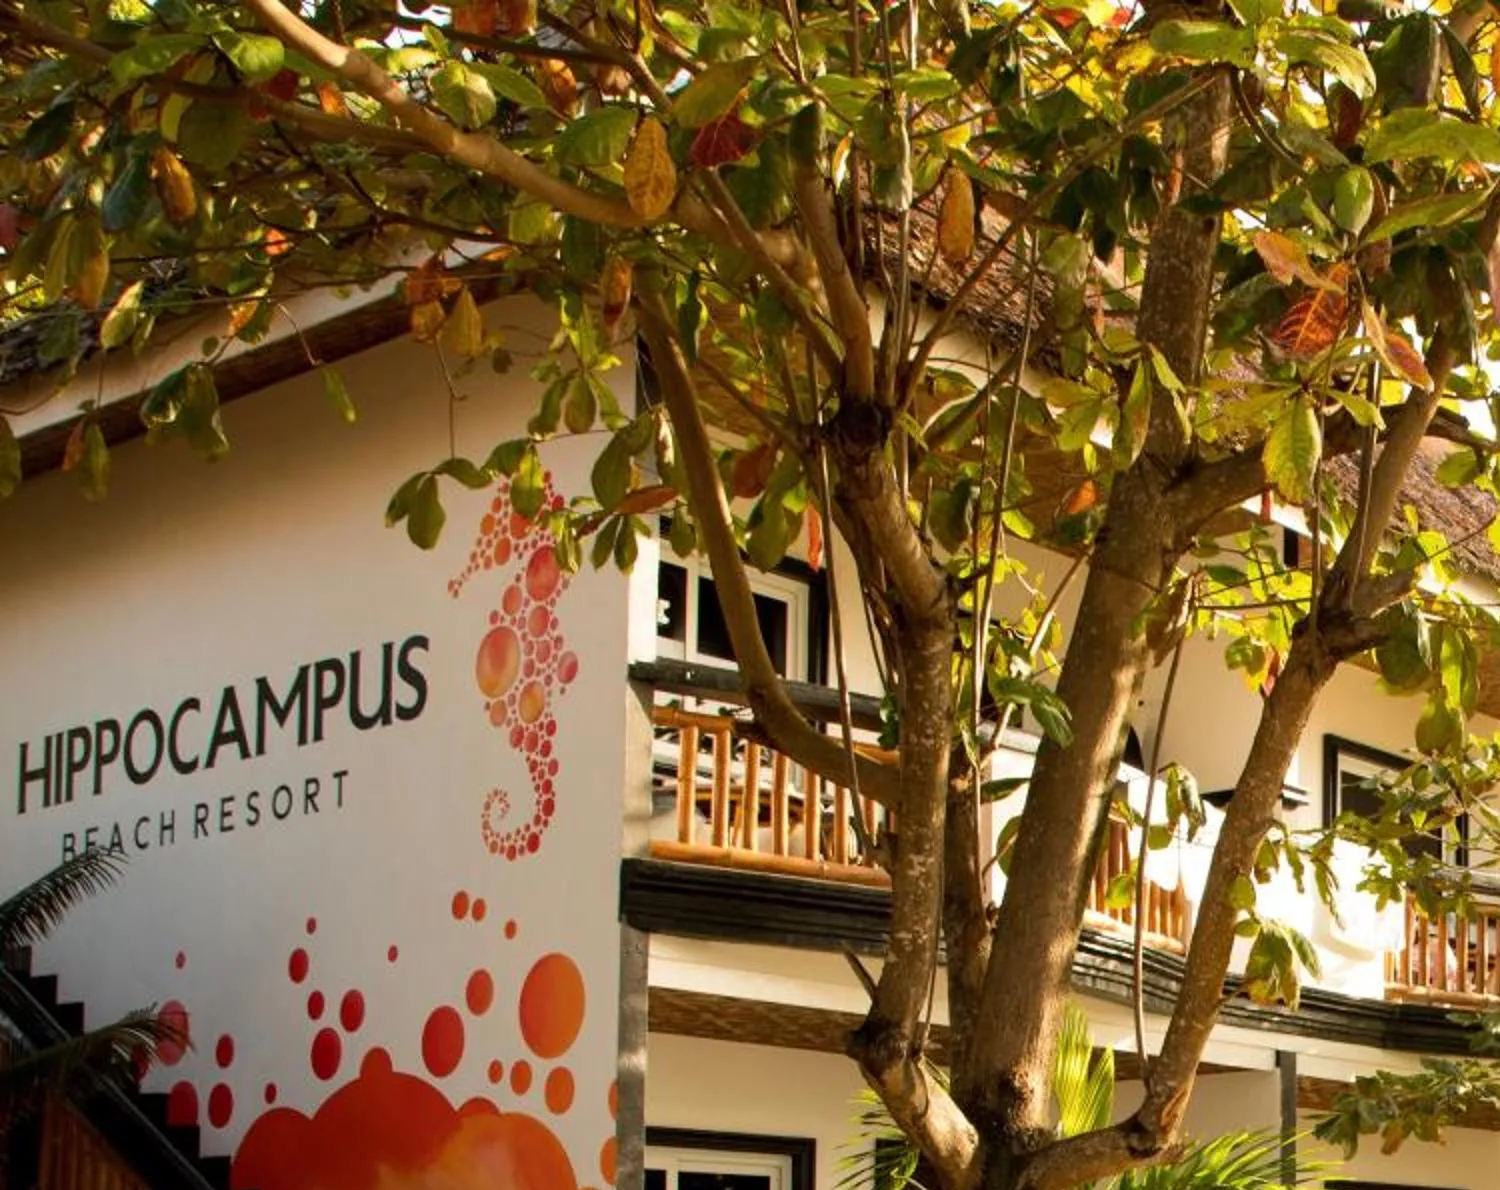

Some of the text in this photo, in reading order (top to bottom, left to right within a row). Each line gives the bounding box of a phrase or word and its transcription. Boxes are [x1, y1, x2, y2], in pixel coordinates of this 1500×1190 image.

[17, 635, 430, 815] HIPPOCAMPUS
[63, 769, 350, 864] BEACH RESORT
